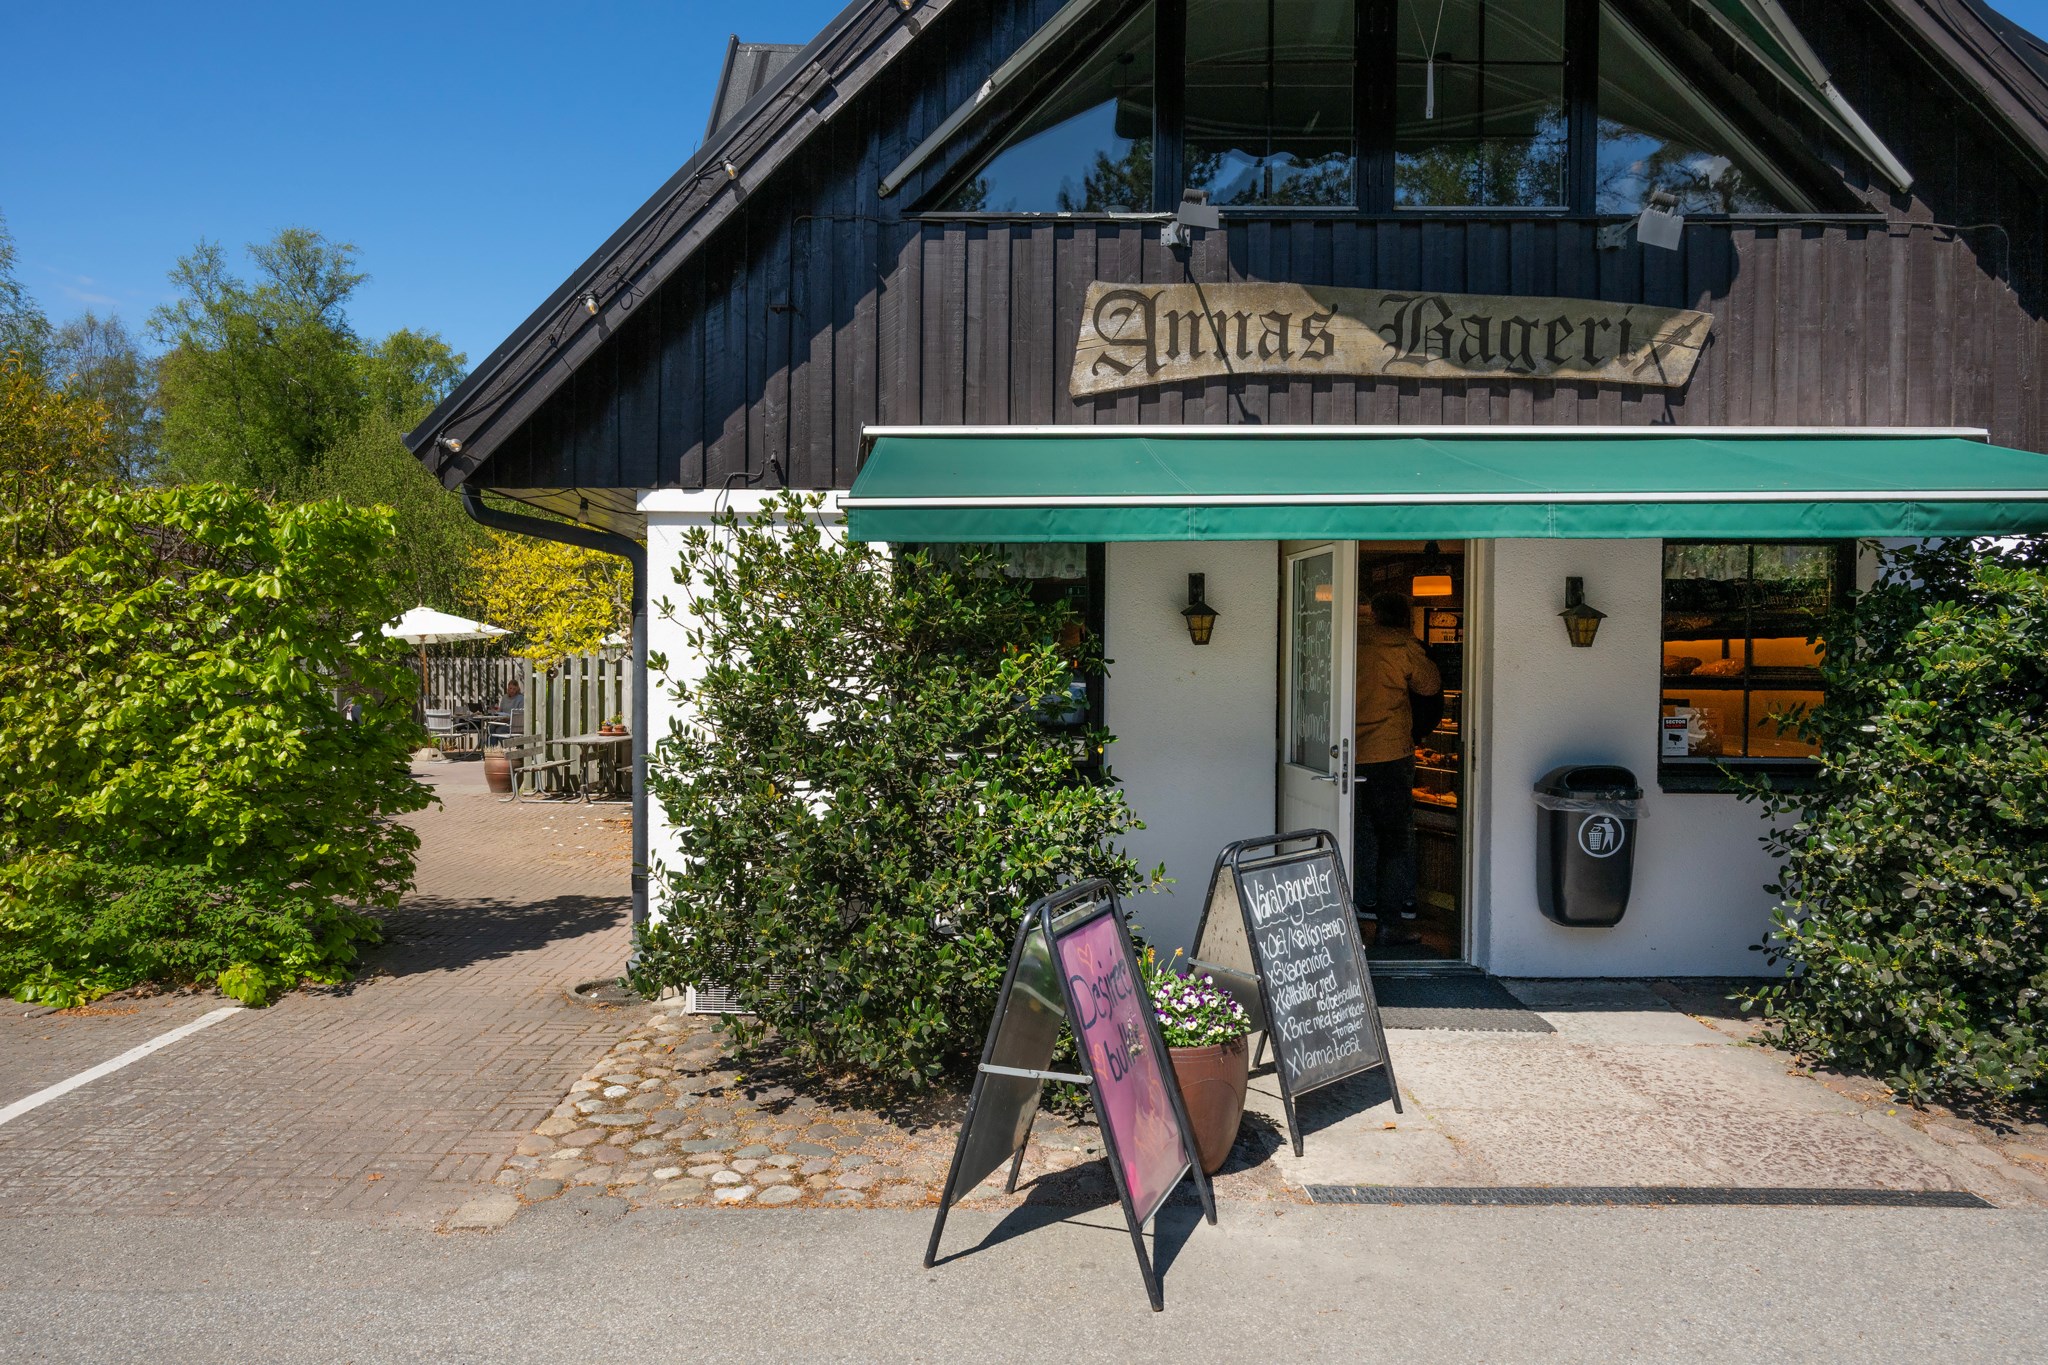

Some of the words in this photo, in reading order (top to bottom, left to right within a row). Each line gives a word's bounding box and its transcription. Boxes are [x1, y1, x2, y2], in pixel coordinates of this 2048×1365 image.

[1091, 288, 1339, 377] Annas
[1374, 293, 1637, 375] Bageri
[1243, 879, 1282, 925] Våra
[1271, 863, 1332, 926] baguetter
[1319, 969, 1339, 995] med
[1287, 1016, 1314, 1039] Brie
[1313, 1010, 1333, 1031] med
[1294, 1039, 1337, 1070] Varma
[1331, 1033, 1363, 1061] toast
